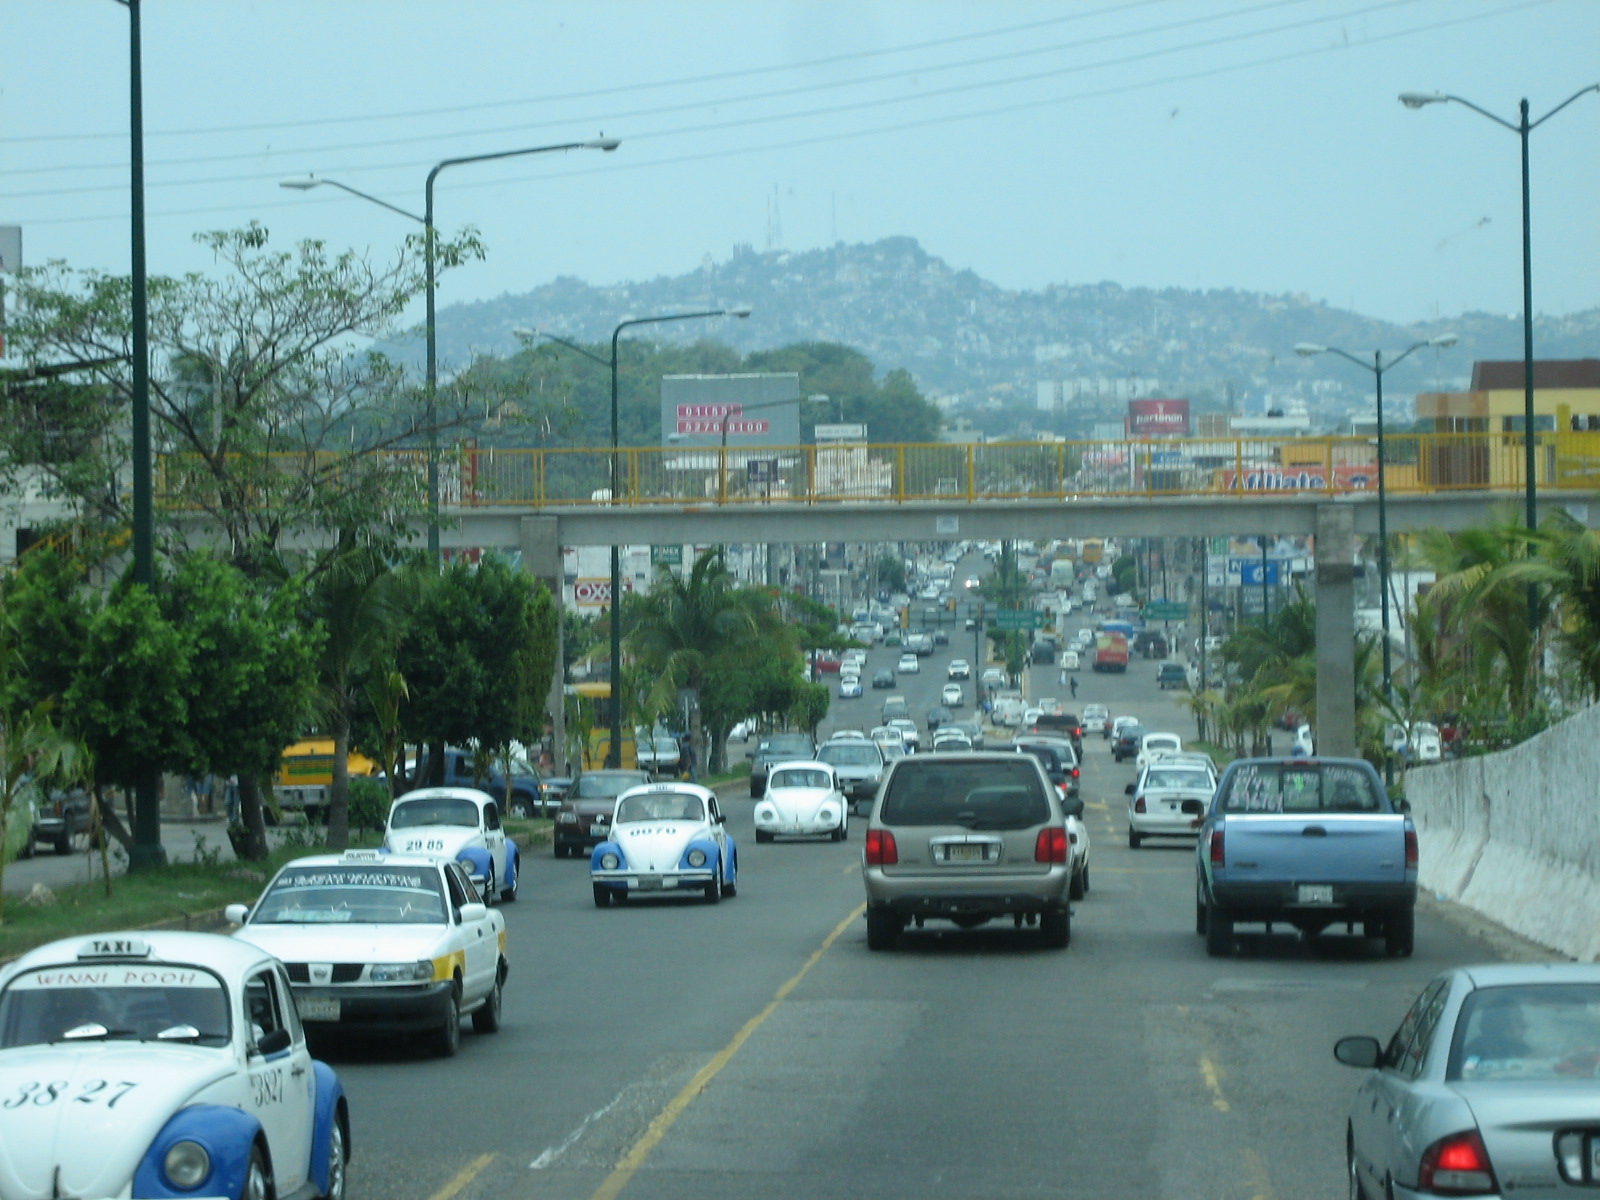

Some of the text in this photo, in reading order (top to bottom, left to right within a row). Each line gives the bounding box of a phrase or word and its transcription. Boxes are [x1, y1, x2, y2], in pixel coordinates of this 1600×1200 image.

[577, 583, 619, 600] OXX
[93, 940, 132, 953] TAXI
[37, 971, 196, 985] WINNI POOH
